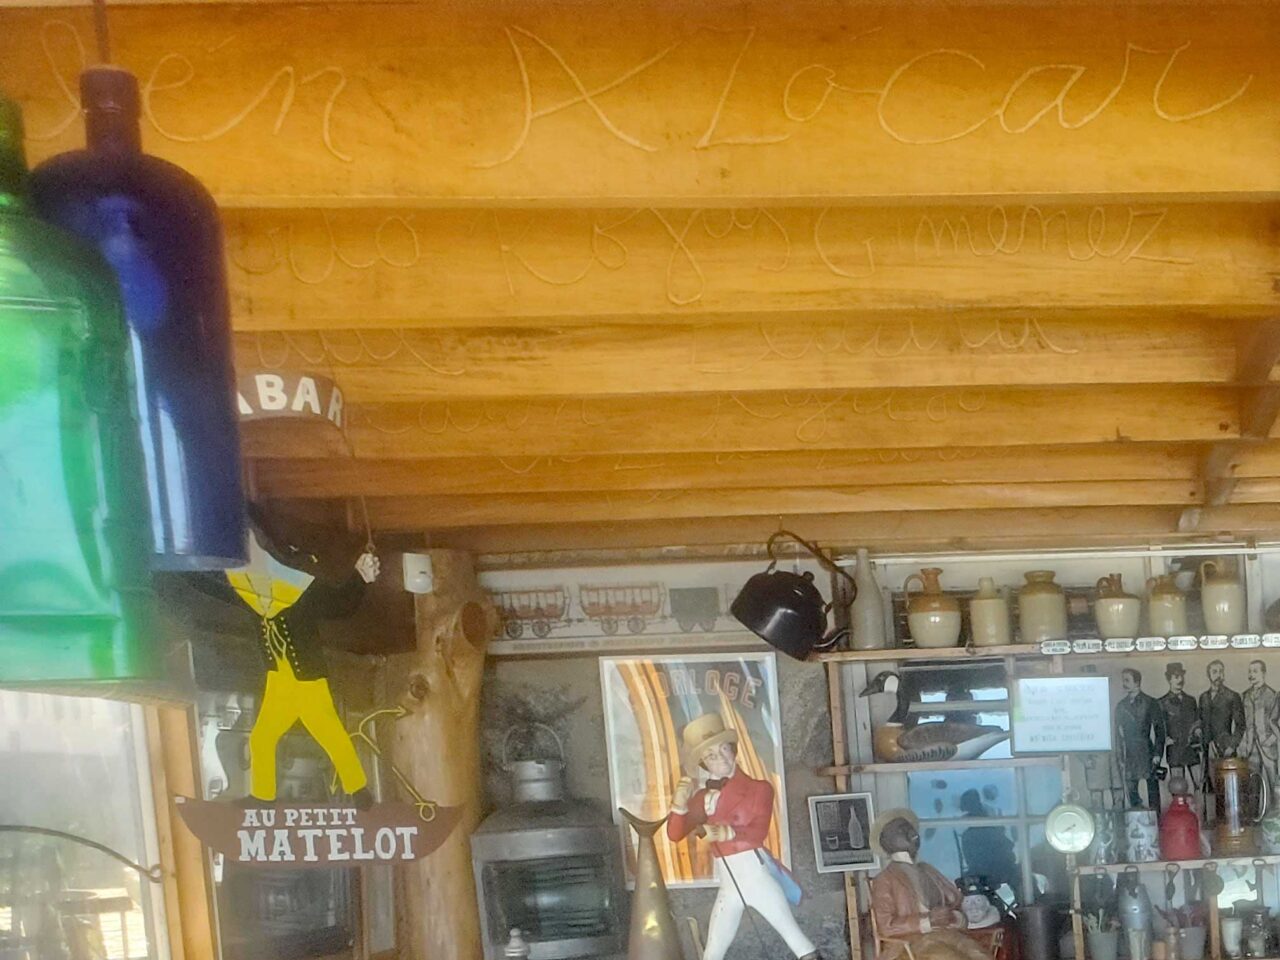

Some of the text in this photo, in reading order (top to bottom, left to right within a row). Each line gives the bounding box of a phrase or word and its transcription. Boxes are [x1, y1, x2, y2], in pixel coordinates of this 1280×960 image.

[242, 807, 358, 828] AU PETIT
[236, 826, 418, 862] MATELOT
